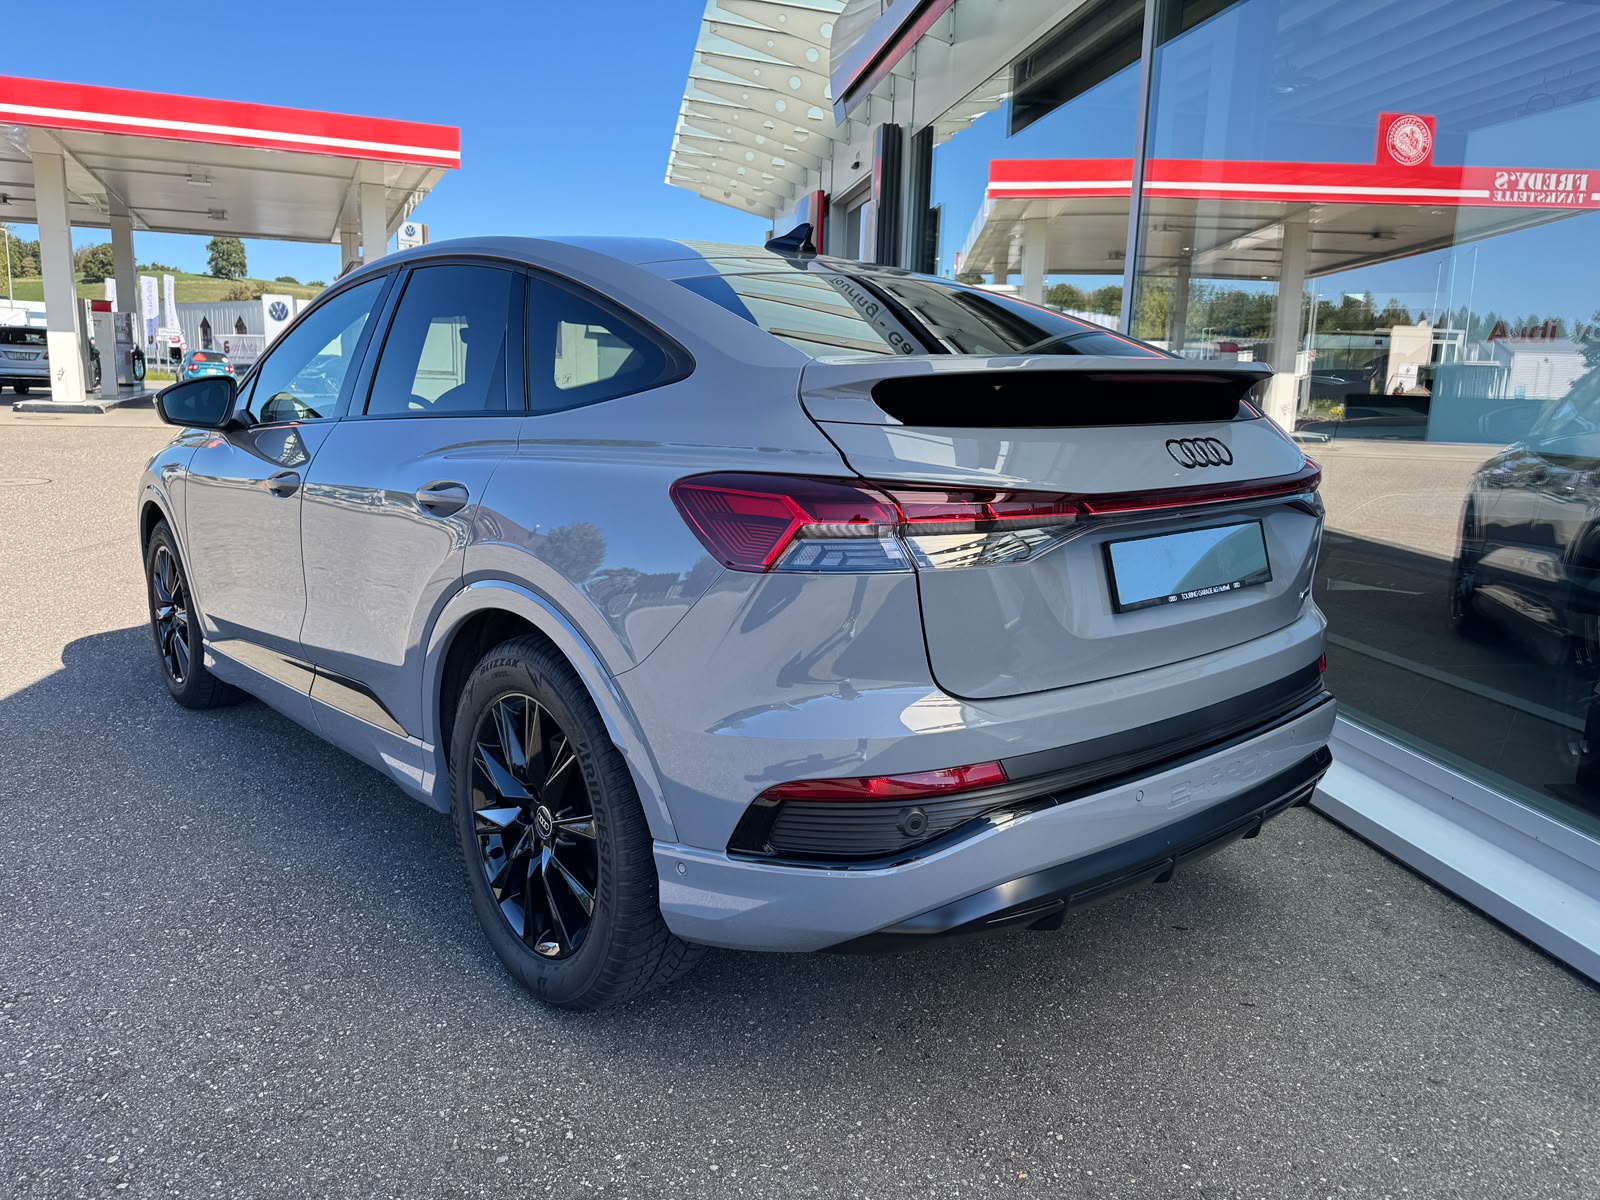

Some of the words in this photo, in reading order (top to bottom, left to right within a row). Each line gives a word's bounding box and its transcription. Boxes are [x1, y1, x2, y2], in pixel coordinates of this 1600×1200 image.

[1486, 319, 1558, 343] Audi
[1180, 590, 1198, 601] TOURING
[1197, 587, 1213, 598] GARAGE
[480, 658, 520, 677] BLIZZAK
[576, 738, 612, 915] BRIDGESTONE
